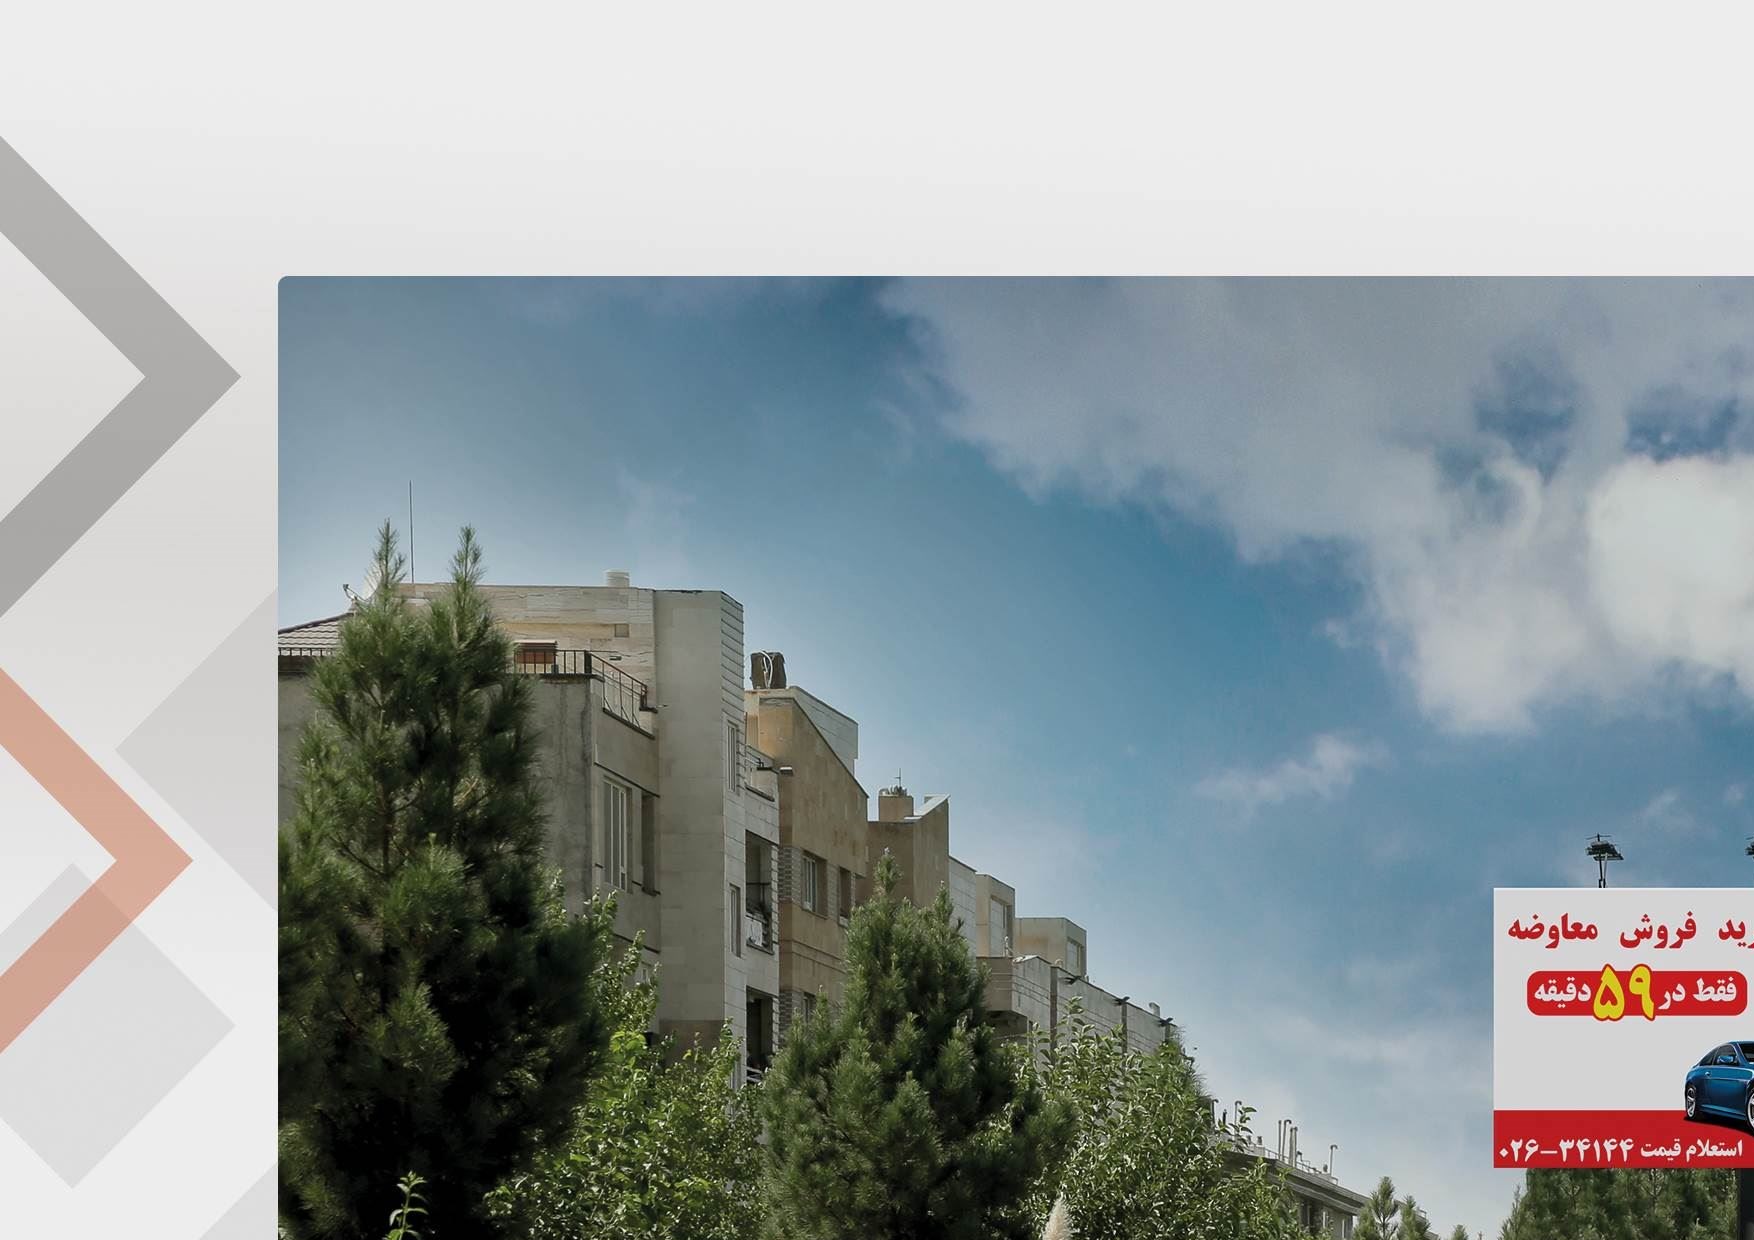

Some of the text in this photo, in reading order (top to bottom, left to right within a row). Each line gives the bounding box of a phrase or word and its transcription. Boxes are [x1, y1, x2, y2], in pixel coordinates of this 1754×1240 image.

[1508, 912, 1598, 949] معاوضه
[1619, 911, 1697, 949] فروش
[1534, 964, 1737, 1020] فقط در ۵۹ دقیقه
[1640, 1138, 1682, 1161] قیمت
[1685, 1138, 1743, 1162] استعلام
